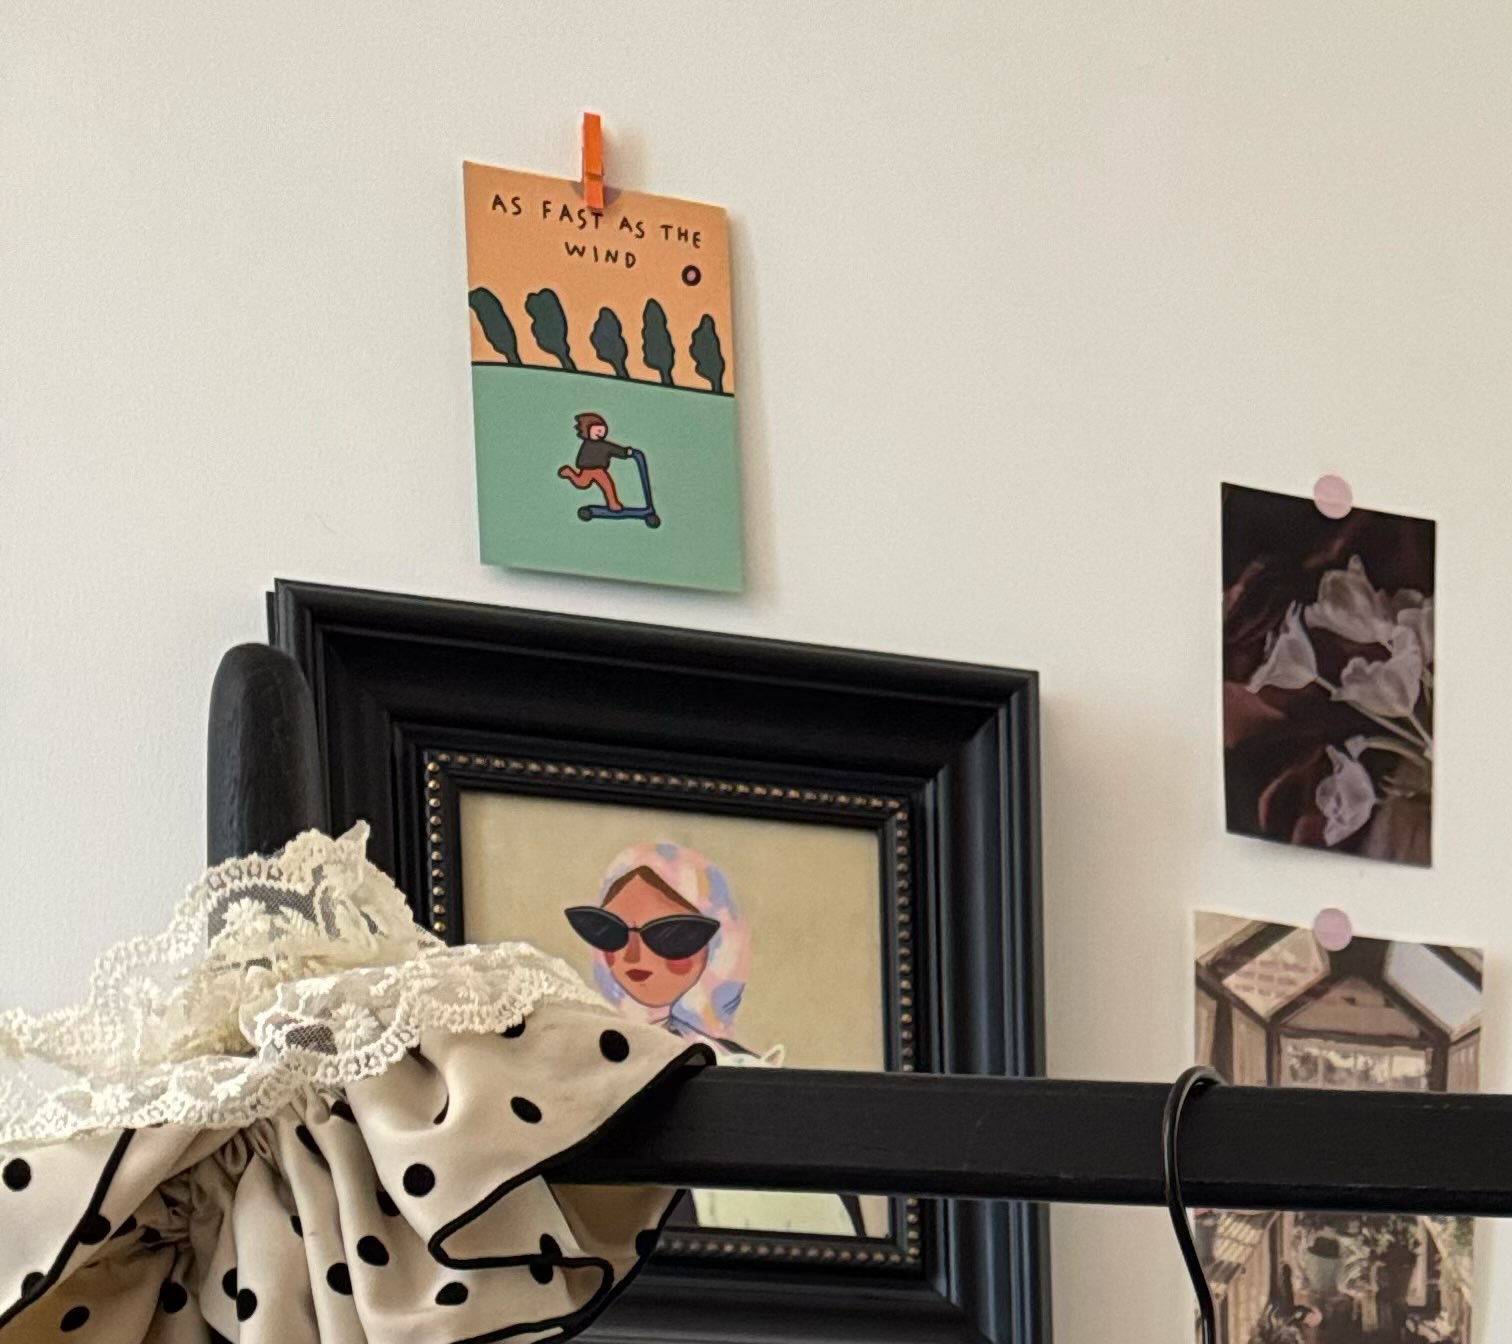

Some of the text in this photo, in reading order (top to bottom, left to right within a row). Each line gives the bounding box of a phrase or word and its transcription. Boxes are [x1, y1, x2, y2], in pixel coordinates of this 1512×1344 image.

[491, 193, 702, 249] AS FAST AS THE
[563, 241, 637, 269] WIND
